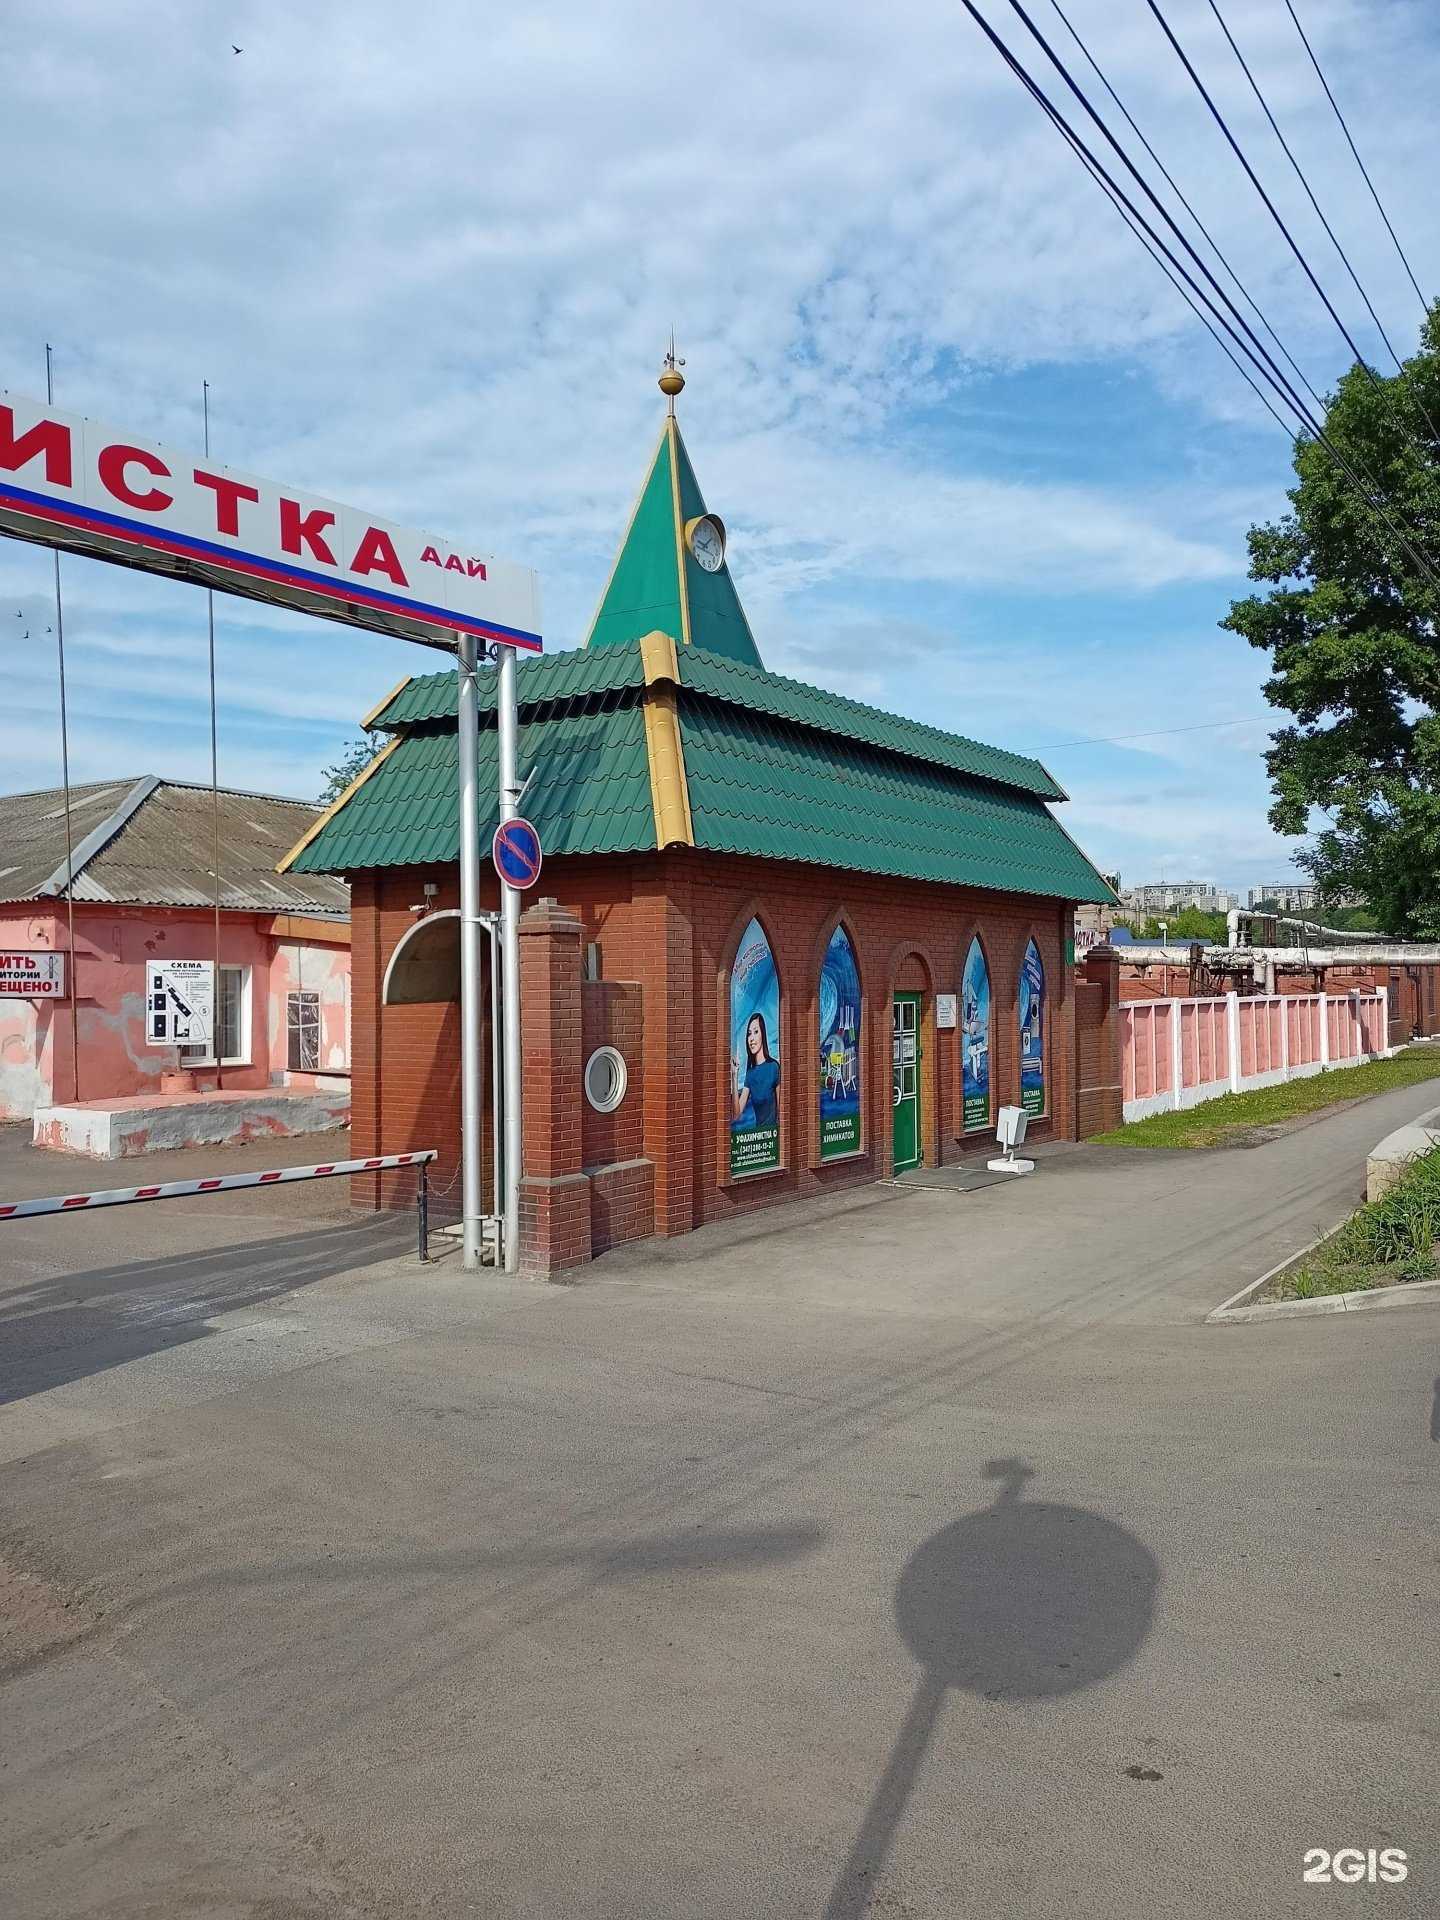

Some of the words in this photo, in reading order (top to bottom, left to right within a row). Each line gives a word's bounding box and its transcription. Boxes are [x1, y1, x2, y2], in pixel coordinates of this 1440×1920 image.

[0, 404, 410, 588] ИСТКА
[420, 545, 487, 581] ААЙ
[825, 1119, 853, 1130] ПОСТАВКА
[822, 1130, 855, 1143] ХИМИКАТОВ
